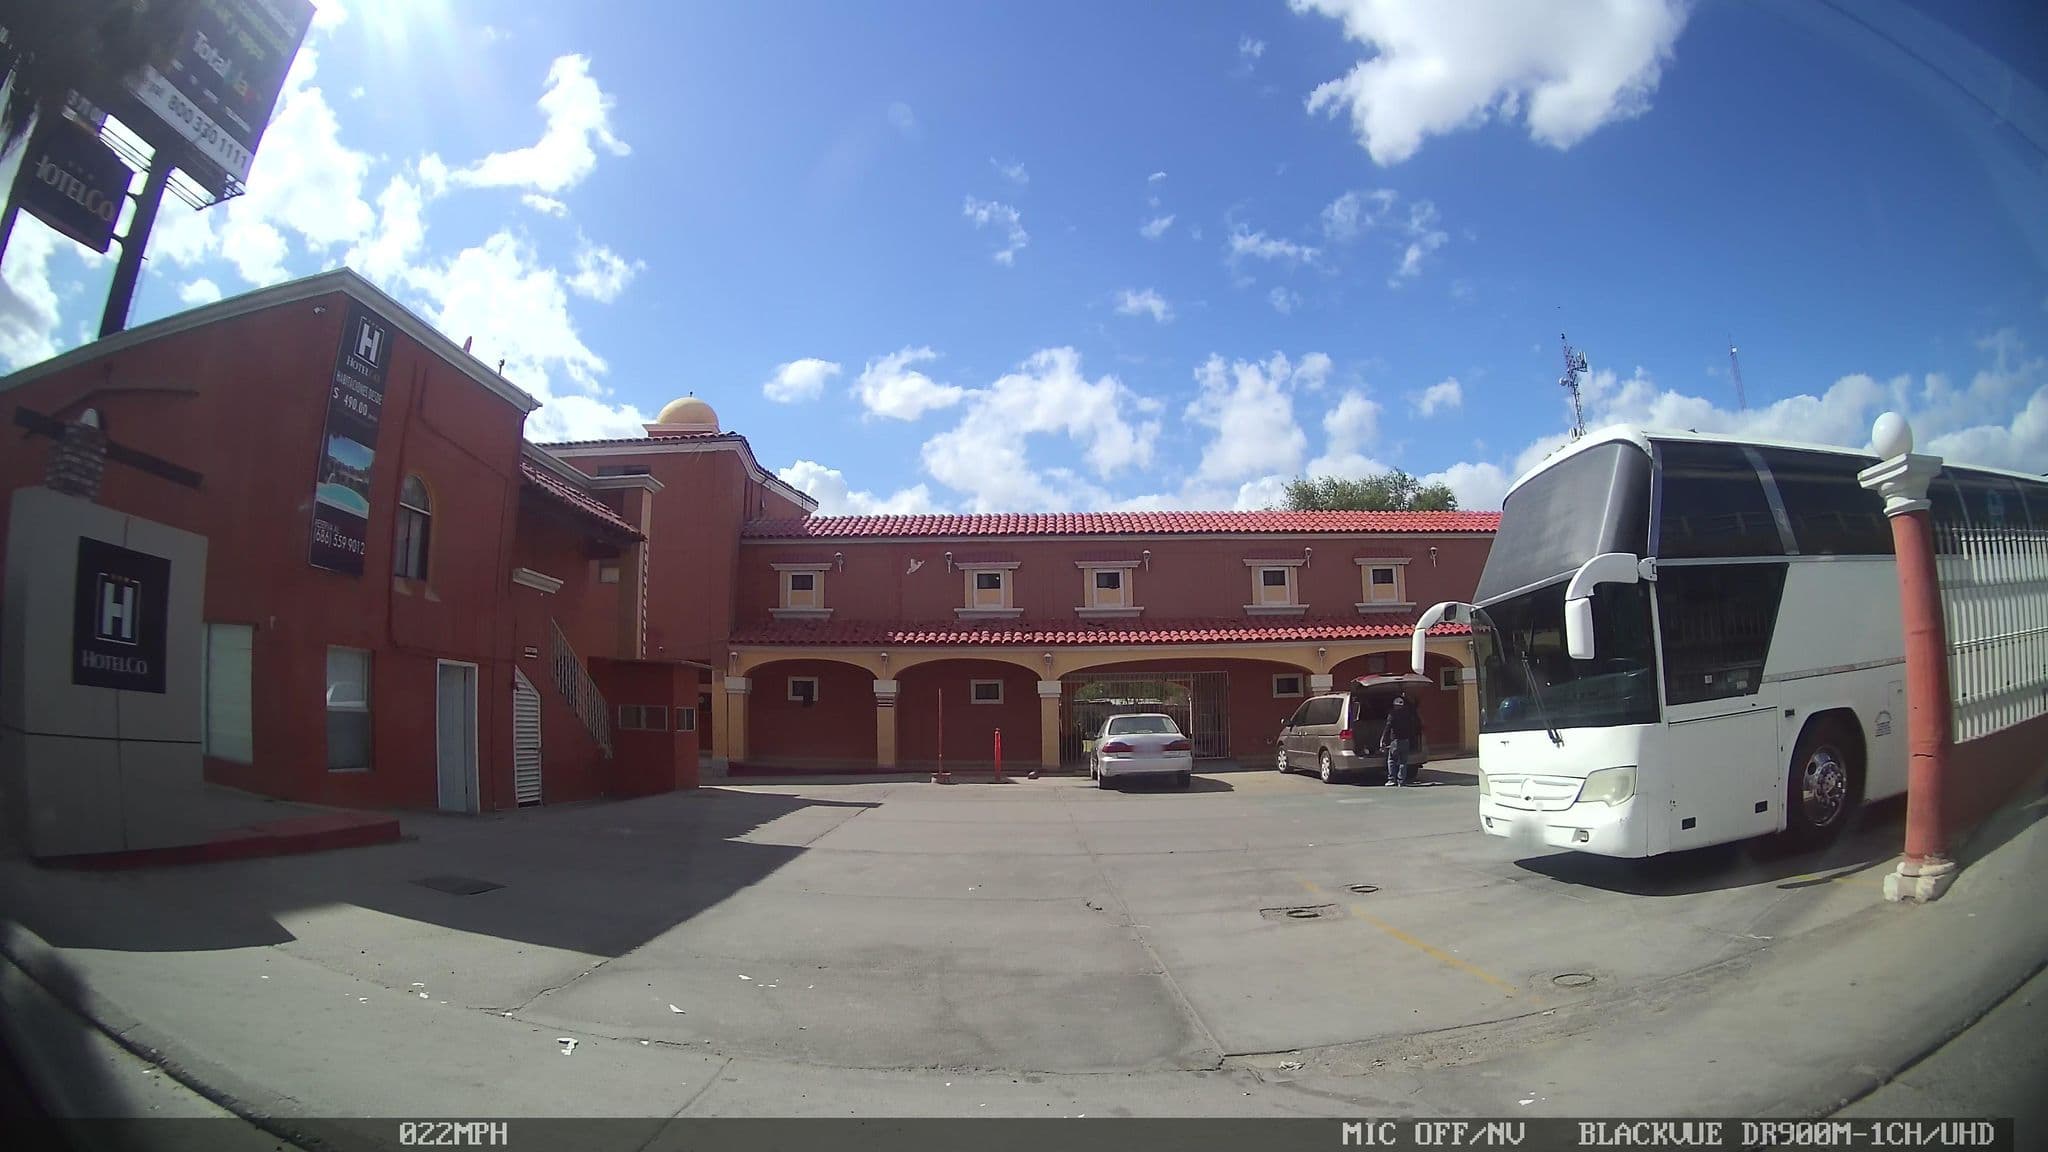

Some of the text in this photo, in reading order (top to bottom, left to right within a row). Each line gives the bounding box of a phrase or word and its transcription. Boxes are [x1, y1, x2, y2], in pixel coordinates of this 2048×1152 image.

[168, 94, 194, 124] 800
[219, 137, 248, 169] 1111
[358, 323, 380, 363] H
[344, 394, 368, 416] 490.00
[313, 527, 366, 555] (686) 559 9012
[103, 582, 134, 638] H
